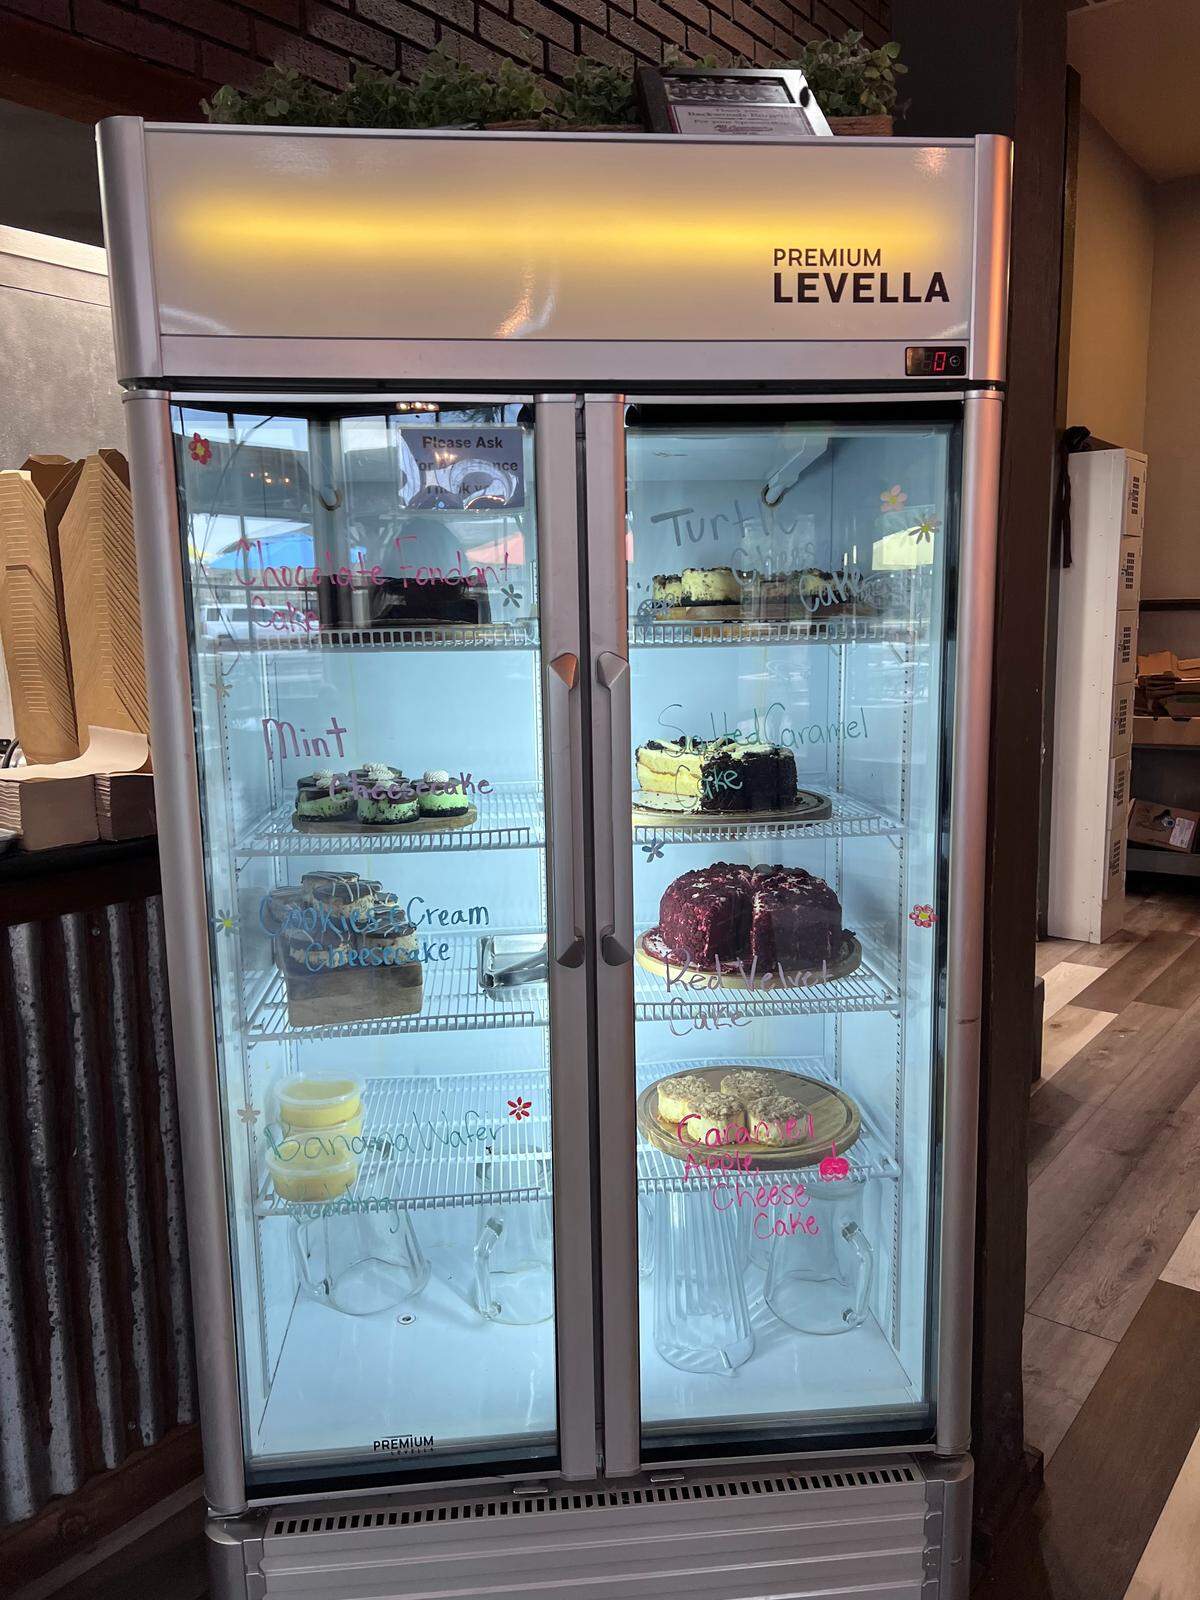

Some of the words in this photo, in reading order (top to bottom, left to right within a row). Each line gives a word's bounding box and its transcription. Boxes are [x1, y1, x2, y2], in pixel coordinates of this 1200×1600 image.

[773, 248, 881, 267] PREMIUM
[773, 271, 950, 303] LEVELLA
[422, 436, 472, 449] Please
[475, 436, 504, 449] Ask
[235, 536, 385, 593] Chocolate
[394, 535, 510, 589] Fondant
[251, 595, 322, 633] Cake
[261, 717, 348, 760] Mint
[763, 702, 869, 749] Caramel
[674, 764, 743, 809] Cake
[405, 896, 490, 929] Cream
[664, 949, 724, 993] Red
[735, 954, 834, 992] Velvet
[669, 997, 753, 1036] Cake
[264, 1122, 416, 1162] Banana
[412, 1109, 505, 1151] Wafer
[712, 1182, 811, 1211] Cheese
[754, 1212, 820, 1240] Cake
[373, 1435, 434, 1452] PREMIUM
